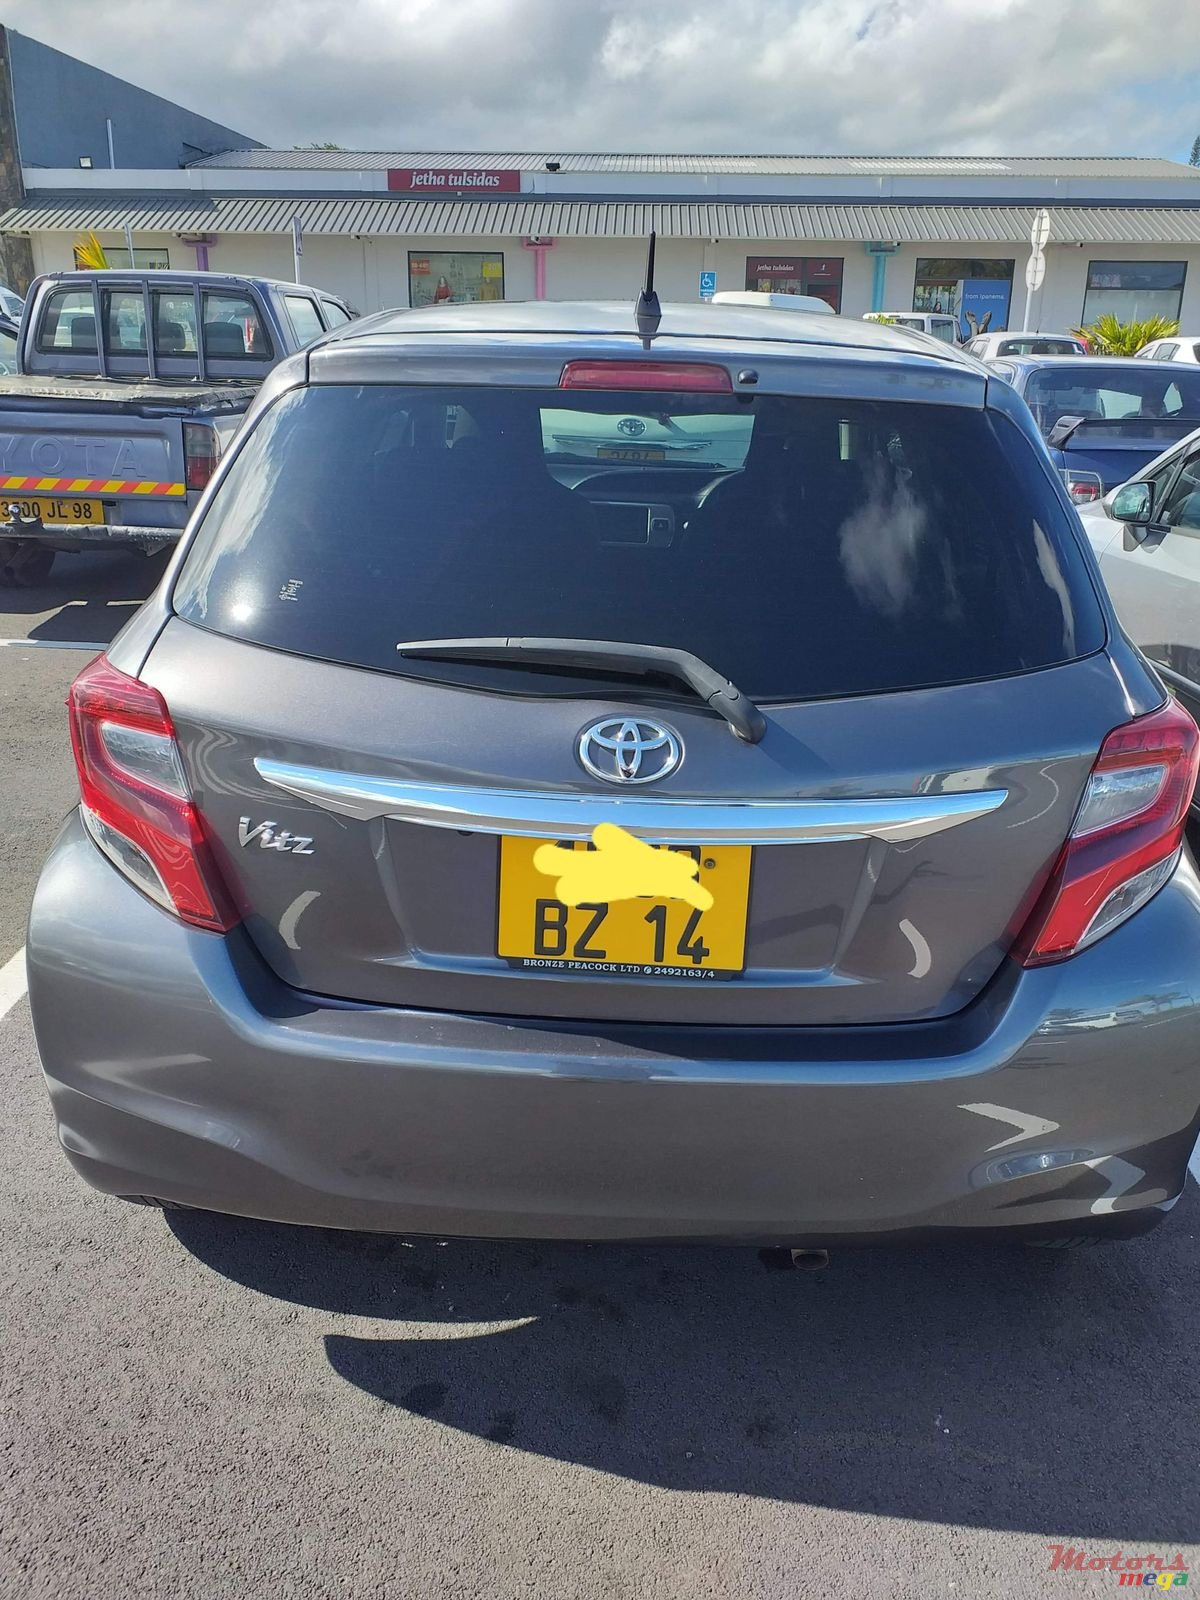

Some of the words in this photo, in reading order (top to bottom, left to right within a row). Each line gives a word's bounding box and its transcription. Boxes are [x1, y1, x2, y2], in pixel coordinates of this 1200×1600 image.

[410, 171, 445, 188] jetha
[448, 171, 500, 187] tulsidas
[47, 502, 68, 519] JL
[73, 503, 92, 519] 98
[239, 816, 316, 855] Vitz
[534, 898, 608, 959] BZ
[644, 905, 710, 965] 14
[523, 958, 565, 969] BRONZE
[567, 961, 617, 972] PEACOCK
[620, 965, 641, 974] LTD
[654, 966, 715, 979] 2492163/4
